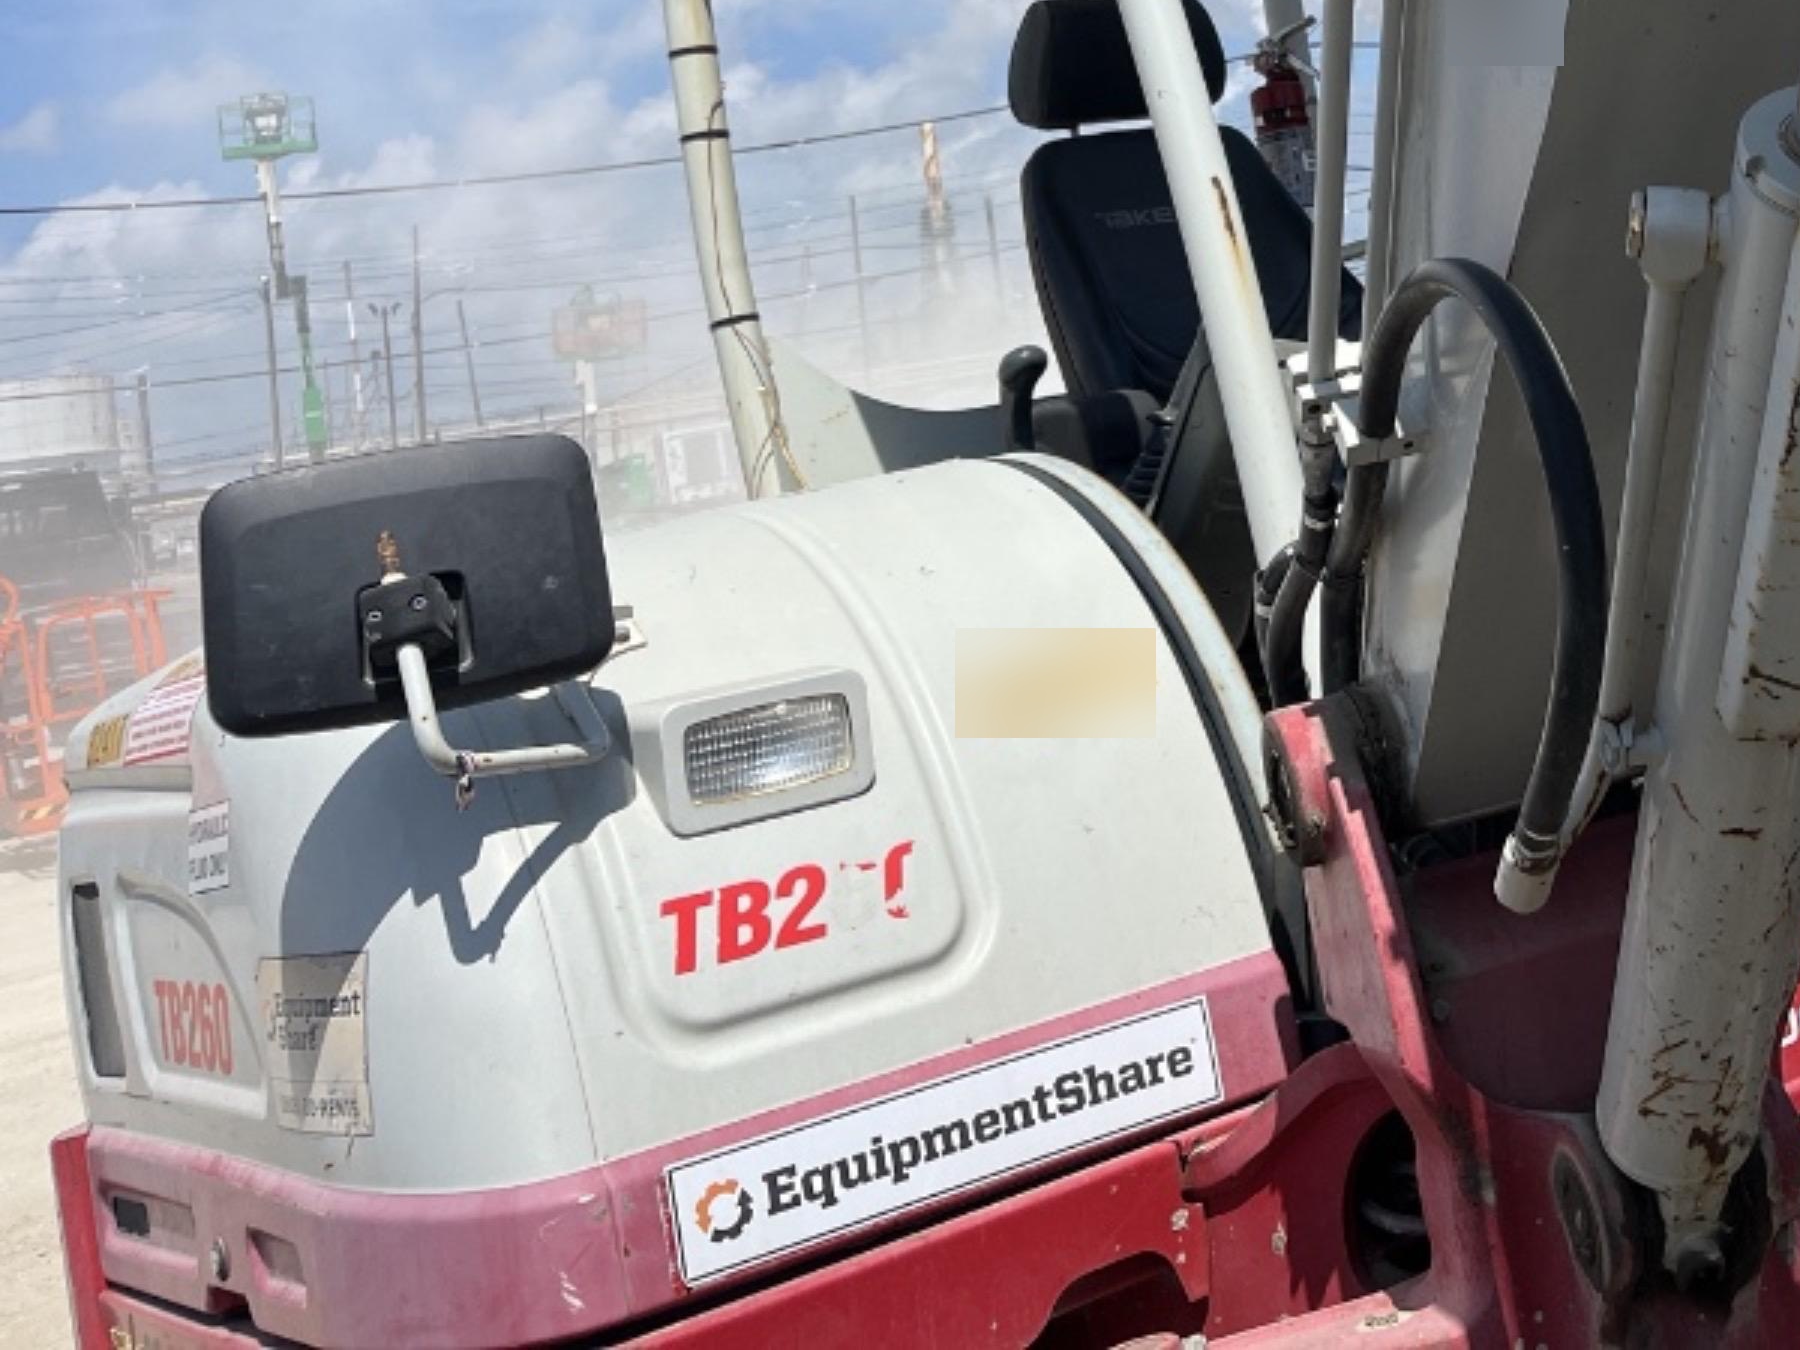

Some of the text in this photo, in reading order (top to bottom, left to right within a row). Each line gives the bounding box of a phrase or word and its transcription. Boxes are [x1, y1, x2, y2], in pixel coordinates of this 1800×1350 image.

[153, 979, 233, 1076] TB260
[274, 990, 362, 1023] Equipment
[761, 1044, 1196, 1217] EquipmentShare
